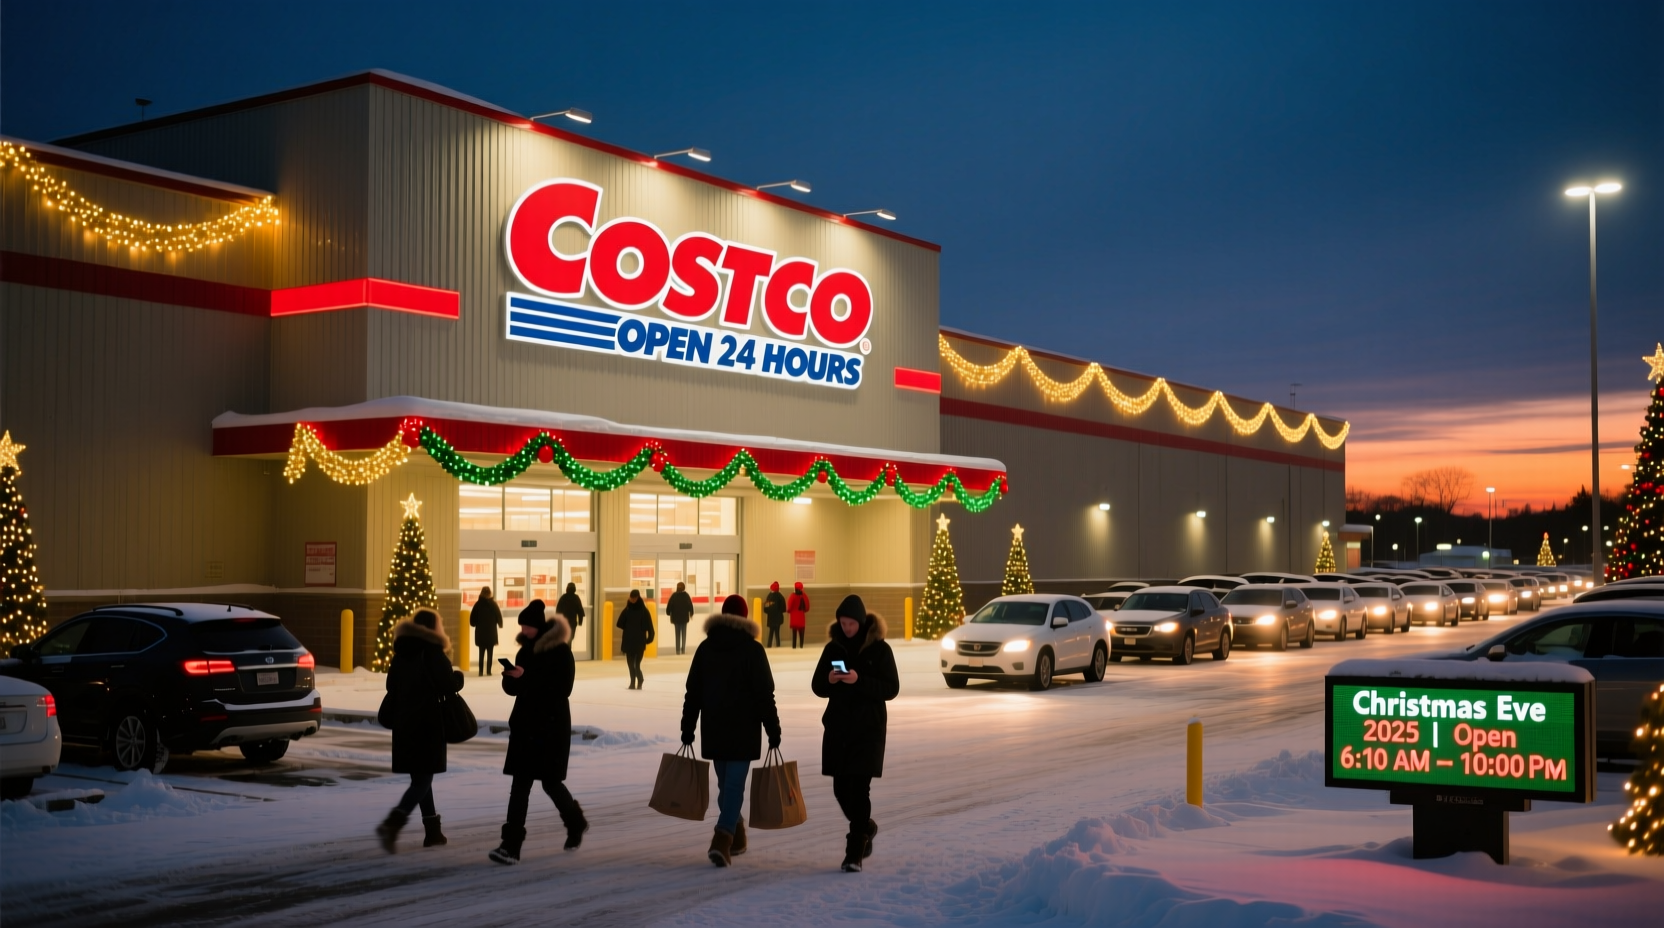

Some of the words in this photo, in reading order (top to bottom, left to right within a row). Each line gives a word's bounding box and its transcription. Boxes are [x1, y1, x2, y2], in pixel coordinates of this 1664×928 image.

[508, 180, 873, 346] COSTCO
[617, 319, 713, 363] OPEN
[717, 335, 756, 370] 24
[762, 343, 862, 385] HOURS
[1352, 690, 1487, 720] Christmas
[1497, 695, 1546, 722] Eve
[1363, 719, 1420, 743] 2025
[1453, 723, 1517, 752] Open
[1340, 745, 1388, 771] 6:10
[1393, 748, 1430, 773] AM
[1460, 752, 1525, 778] 10:00
[1528, 754, 1567, 781] PM
